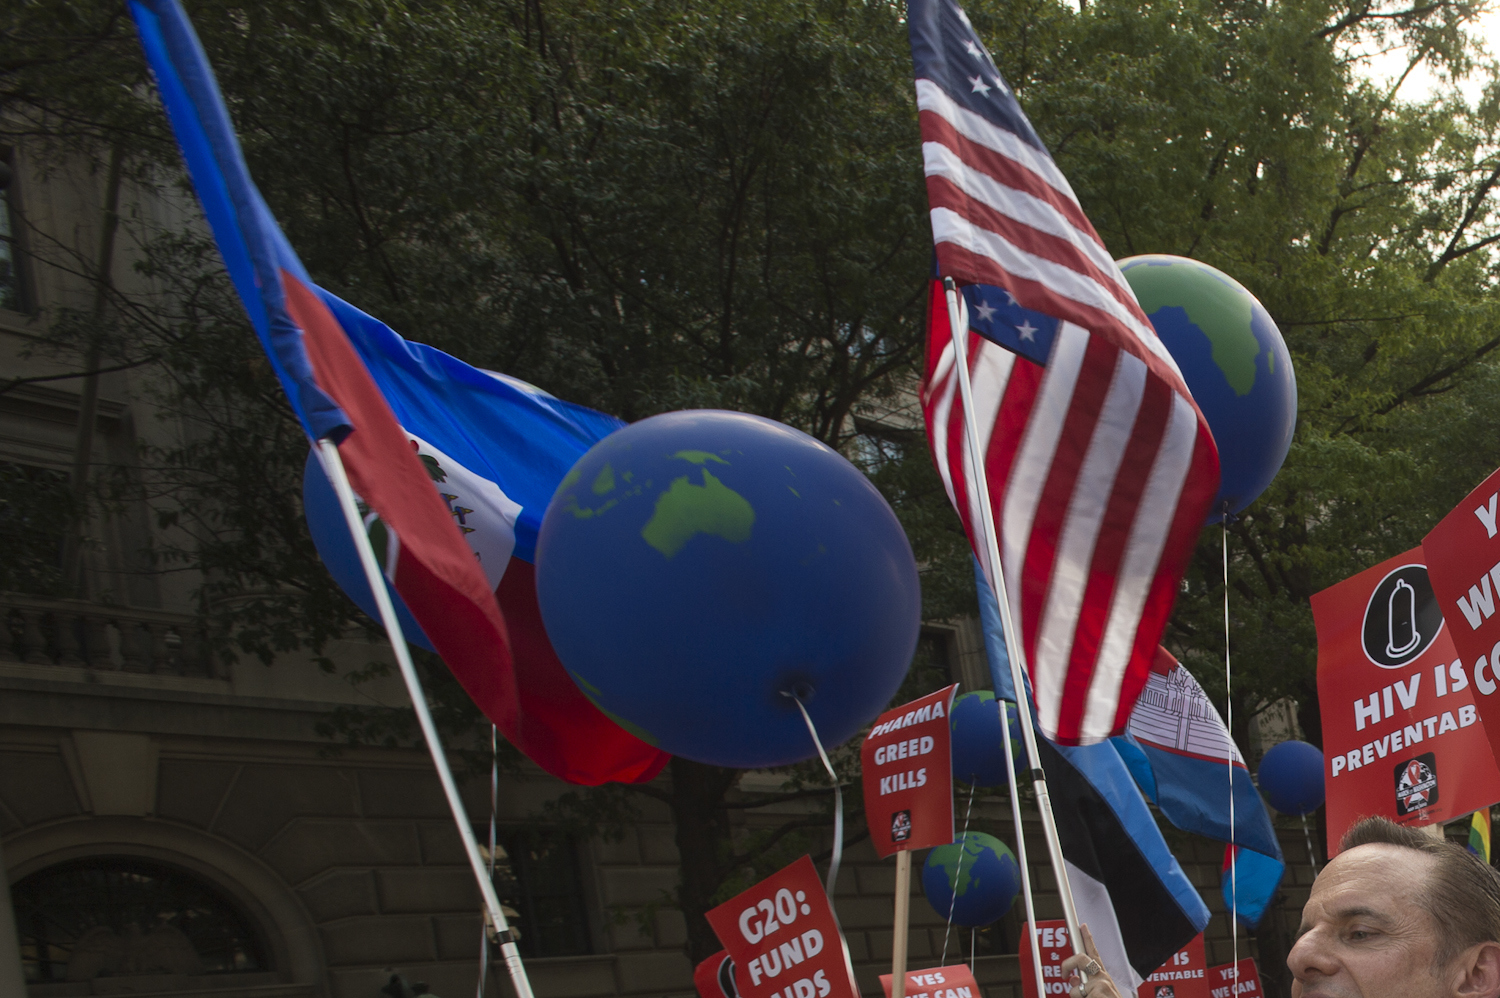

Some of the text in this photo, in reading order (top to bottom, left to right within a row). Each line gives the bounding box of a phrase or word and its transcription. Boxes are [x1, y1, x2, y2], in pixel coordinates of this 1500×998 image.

[1353, 658, 1469, 732] HIV IS
[868, 701, 945, 740] PHARMA
[874, 735, 935, 766] GREED
[1331, 703, 1483, 778] PREVENTAB
[880, 768, 927, 796] KILLS
[738, 888, 811, 945] G20:
[1035, 927, 1071, 949] TES
[747, 928, 825, 987] FUND
[1051, 952, 1060, 961] &
[1173, 951, 1189, 965] IS
[911, 972, 945, 987] YES
[1146, 969, 1204, 982] VENTABLE
[1220, 967, 1239, 980] YES
[1232, 980, 1256, 995] CAN
